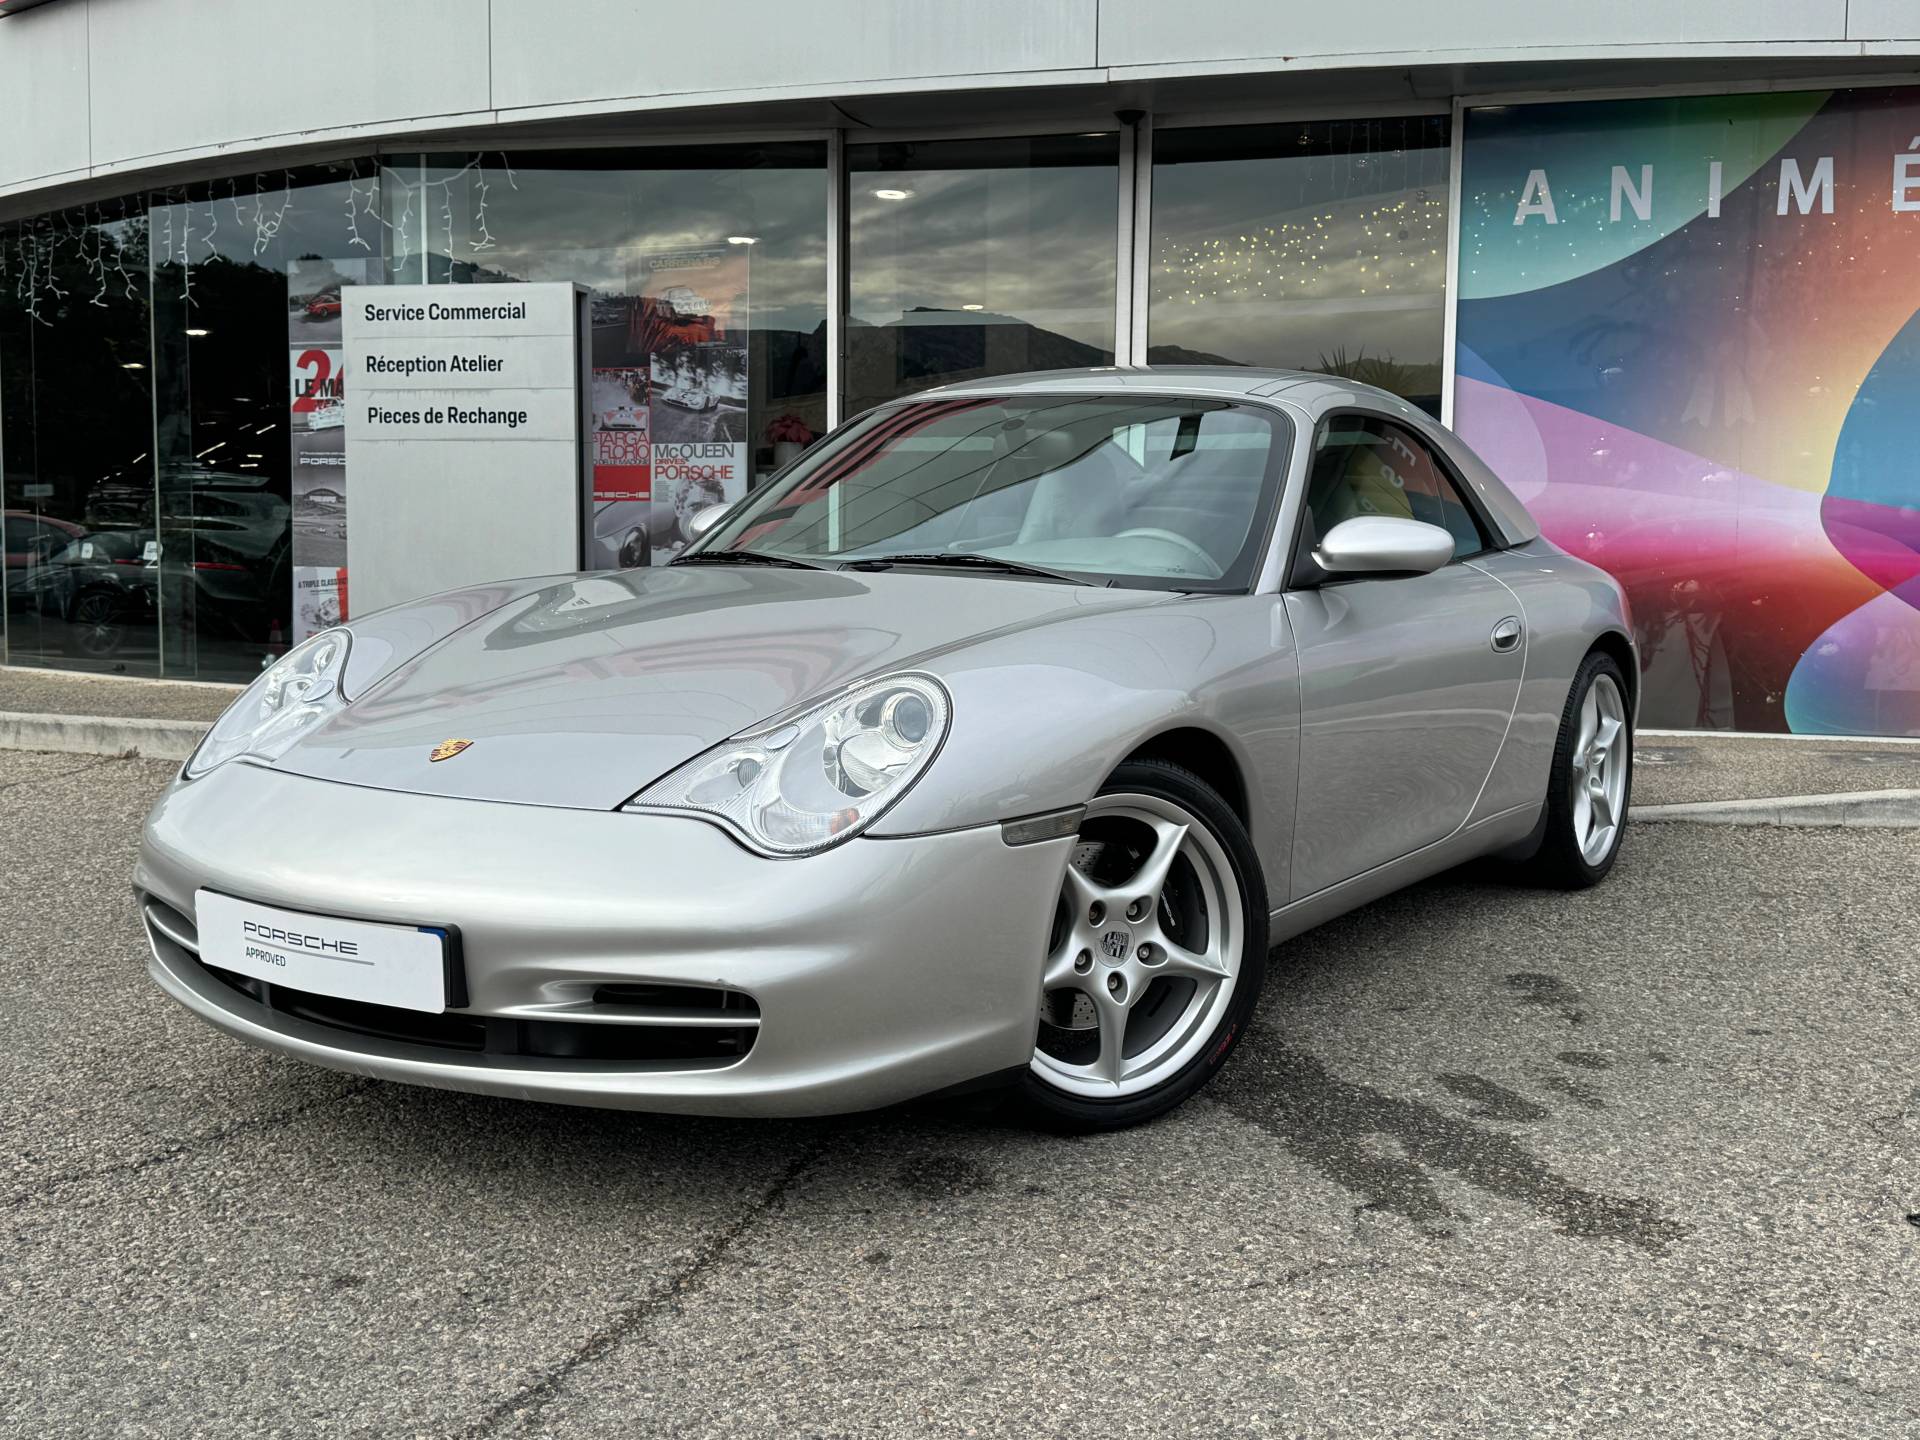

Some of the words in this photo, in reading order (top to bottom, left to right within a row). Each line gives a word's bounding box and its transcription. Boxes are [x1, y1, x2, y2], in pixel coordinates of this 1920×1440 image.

[365, 304, 425, 321] Service
[428, 302, 526, 320] Commercial
[366, 355, 446, 377] Réception
[450, 355, 503, 372] Atelier
[295, 378, 316, 398] LE
[368, 407, 420, 424] Pieces
[424, 407, 444, 424] de
[448, 406, 528, 428] Rechange
[596, 431, 649, 445] TARGA
[600, 445, 649, 460] FLORIO
[655, 443, 734, 461] McQUEEN
[655, 465, 735, 480] PORSCHE
[243, 920, 359, 956] PORSCHE
[245, 945, 286, 967] APPROVED
